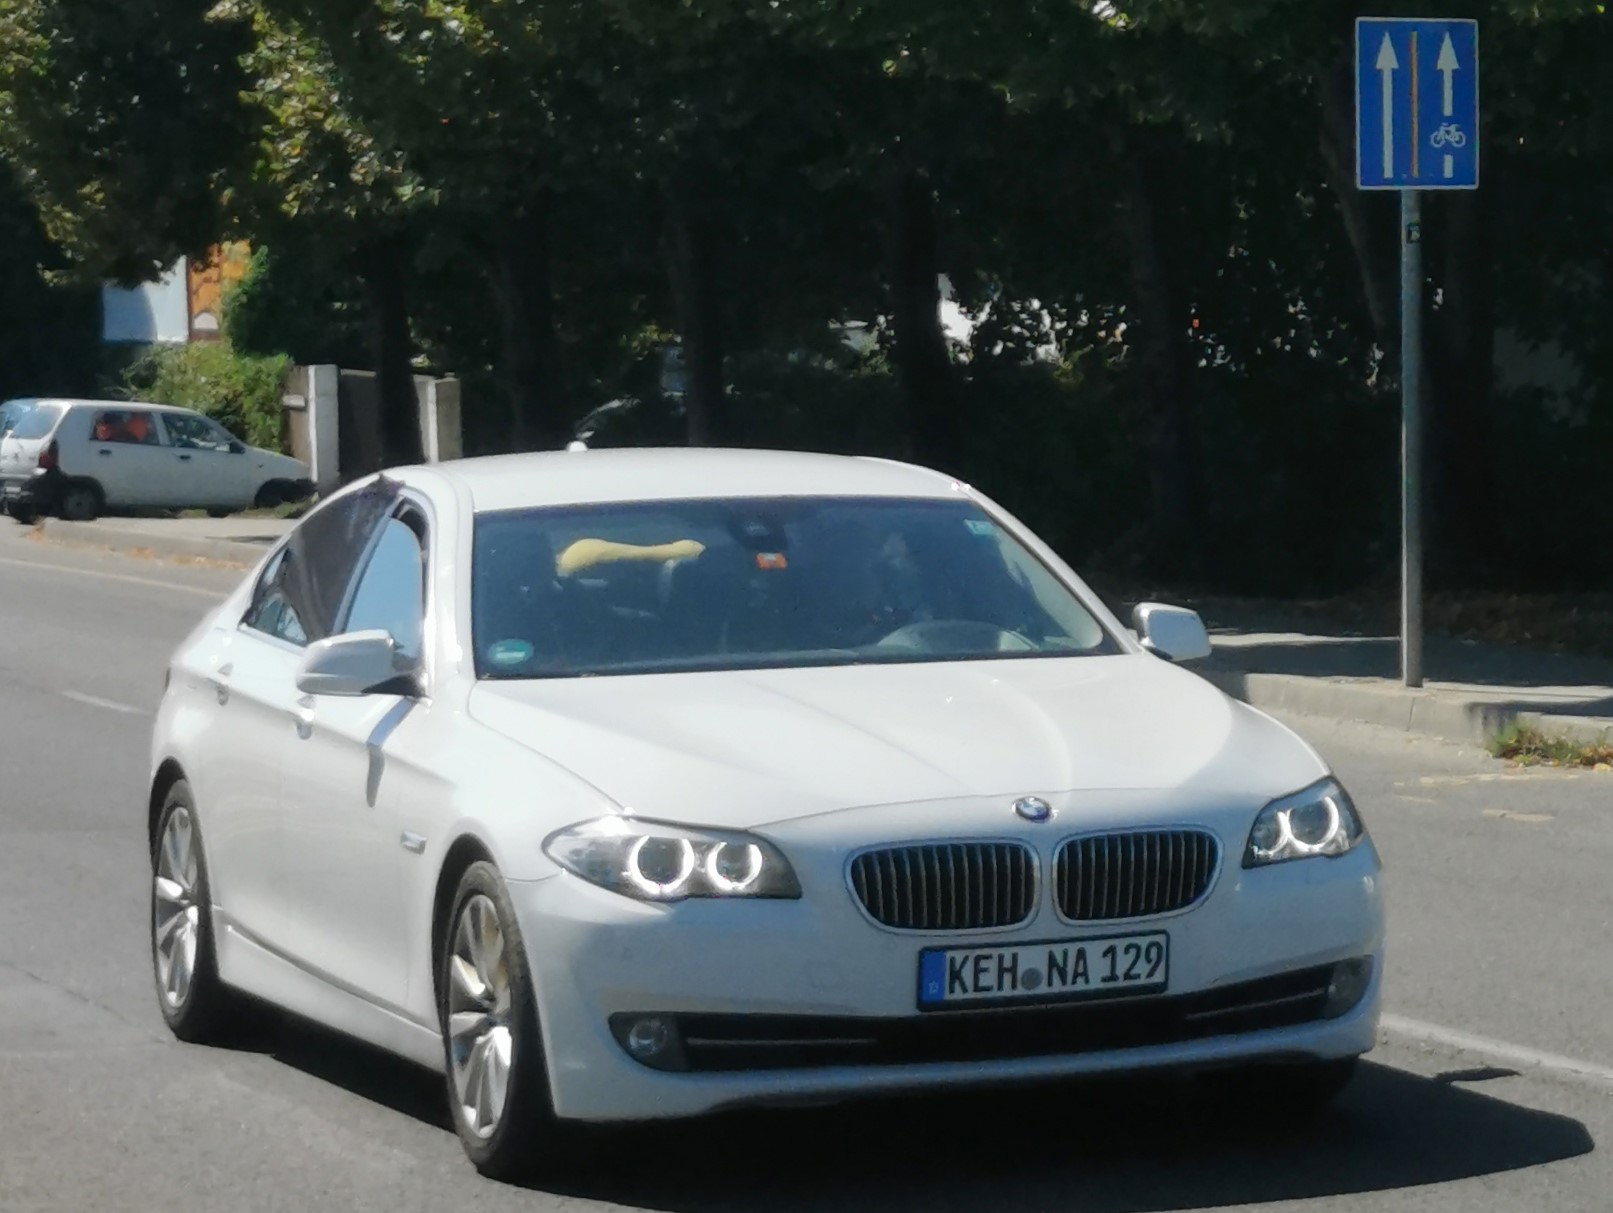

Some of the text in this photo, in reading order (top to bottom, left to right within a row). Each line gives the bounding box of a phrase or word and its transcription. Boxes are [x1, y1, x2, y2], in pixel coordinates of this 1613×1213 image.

[949, 941, 1163, 994] KEH NA 129
